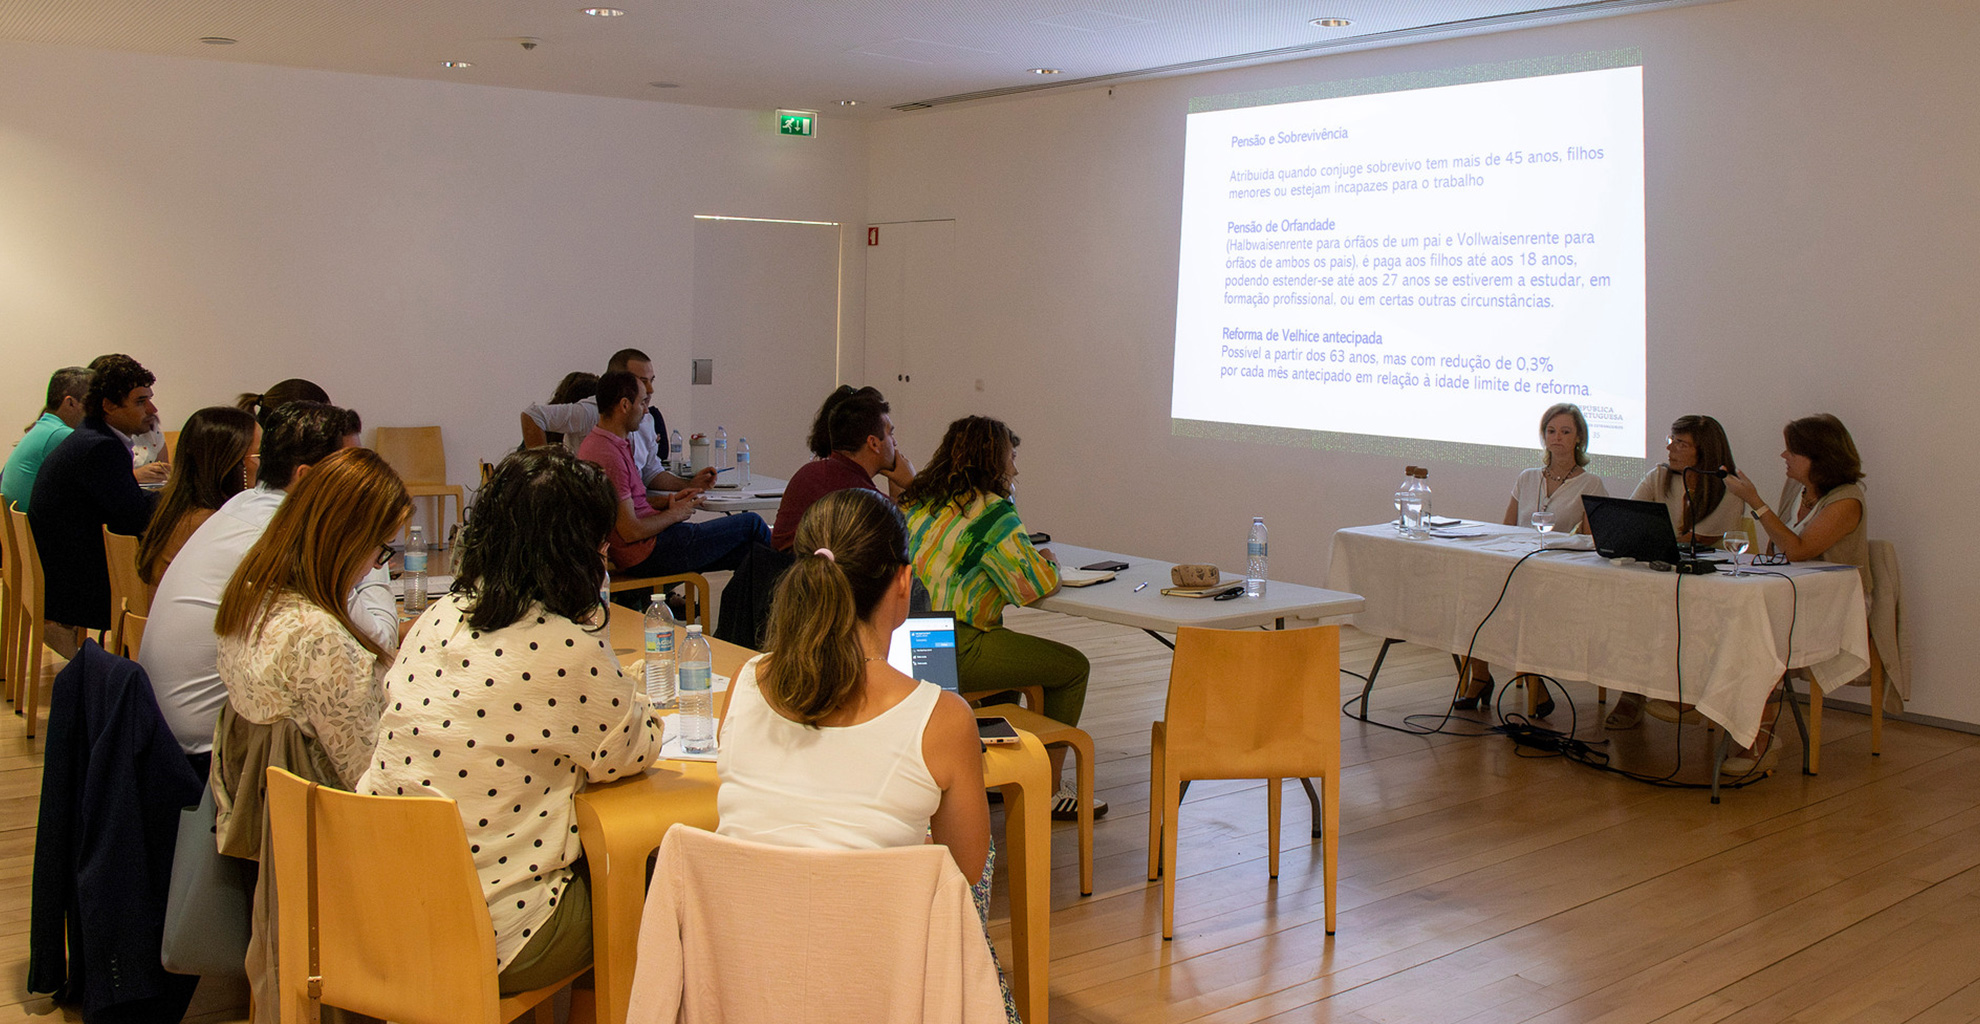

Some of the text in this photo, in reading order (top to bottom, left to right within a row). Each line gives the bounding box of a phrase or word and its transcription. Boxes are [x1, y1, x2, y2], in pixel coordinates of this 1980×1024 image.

[1231, 127, 1349, 148] Pensão e Sobrevivência
[1278, 166, 1317, 182] quando
[1367, 159, 1422, 173] sobrevivo
[1426, 158, 1448, 170] tem
[1453, 155, 1481, 168] mais
[1485, 153, 1501, 166] de
[1505, 151, 1523, 164] 45
[1567, 146, 1604, 160] filhos
[1229, 173, 1484, 199] menores ou estejam incapazes para o trabalho
[1228, 218, 1335, 234] Pensão de Orfandade
[1316, 240, 1340, 252] para
[1344, 235, 1379, 248] órfãos
[1383, 235, 1397, 248] de
[1401, 236, 1419, 247] um
[1423, 234, 1441, 250] pai
[1446, 236, 1453, 246] e
[1565, 233, 1595, 248] para
[1226, 255, 1256, 269] órfãos
[1260, 257, 1272, 268] de
[1275, 256, 1310, 268] ambos
[1314, 258, 1326, 267] os
[1362, 255, 1369, 267] é
[1373, 257, 1401, 270] paga
[1406, 256, 1426, 267] aos
[1430, 253, 1463, 267] filhos
[1467, 253, 1487, 266] até
[1491, 255, 1513, 266] aos
[1520, 252, 1537, 266] 18
[1225, 274, 1269, 289] podendo
[1273, 274, 1334, 286] estender-se
[1337, 274, 1355, 286] até
[1358, 276, 1378, 286] aos
[1382, 274, 1398, 286] 27
[1402, 276, 1430, 287] anos
[1435, 276, 1448, 287] se
[1453, 273, 1513, 287] estiverem
[1518, 276, 1525, 286] a
[1590, 275, 1611, 287] em
[1224, 291, 1270, 308] formação
[1341, 295, 1354, 305] ou
[1358, 294, 1375, 305] em
[1379, 293, 1414, 306] certas
[1418, 294, 1456, 306] outras
[1222, 327, 1383, 347] Reforma de Velhice antecipada
[1221, 345, 1262, 359] Possível
[1265, 349, 1271, 360] a
[1274, 349, 1303, 363] partir
[1306, 348, 1326, 362] dos
[1330, 350, 1345, 362] 63
[1383, 354, 1406, 366] mas
[1411, 355, 1436, 366] com
[1441, 354, 1491, 372] redução
[1496, 357, 1512, 370] de
[1220, 365, 1238, 379] por
[1241, 365, 1264, 378] cada
[1268, 366, 1288, 379] mês
[1292, 368, 1352, 384] antecipado
[1356, 372, 1373, 384] em
[1377, 372, 1419, 389] relação
[1424, 373, 1431, 387] à
[1435, 374, 1469, 389] idade
[1475, 376, 1510, 392] limite
[1514, 378, 1531, 392] de
